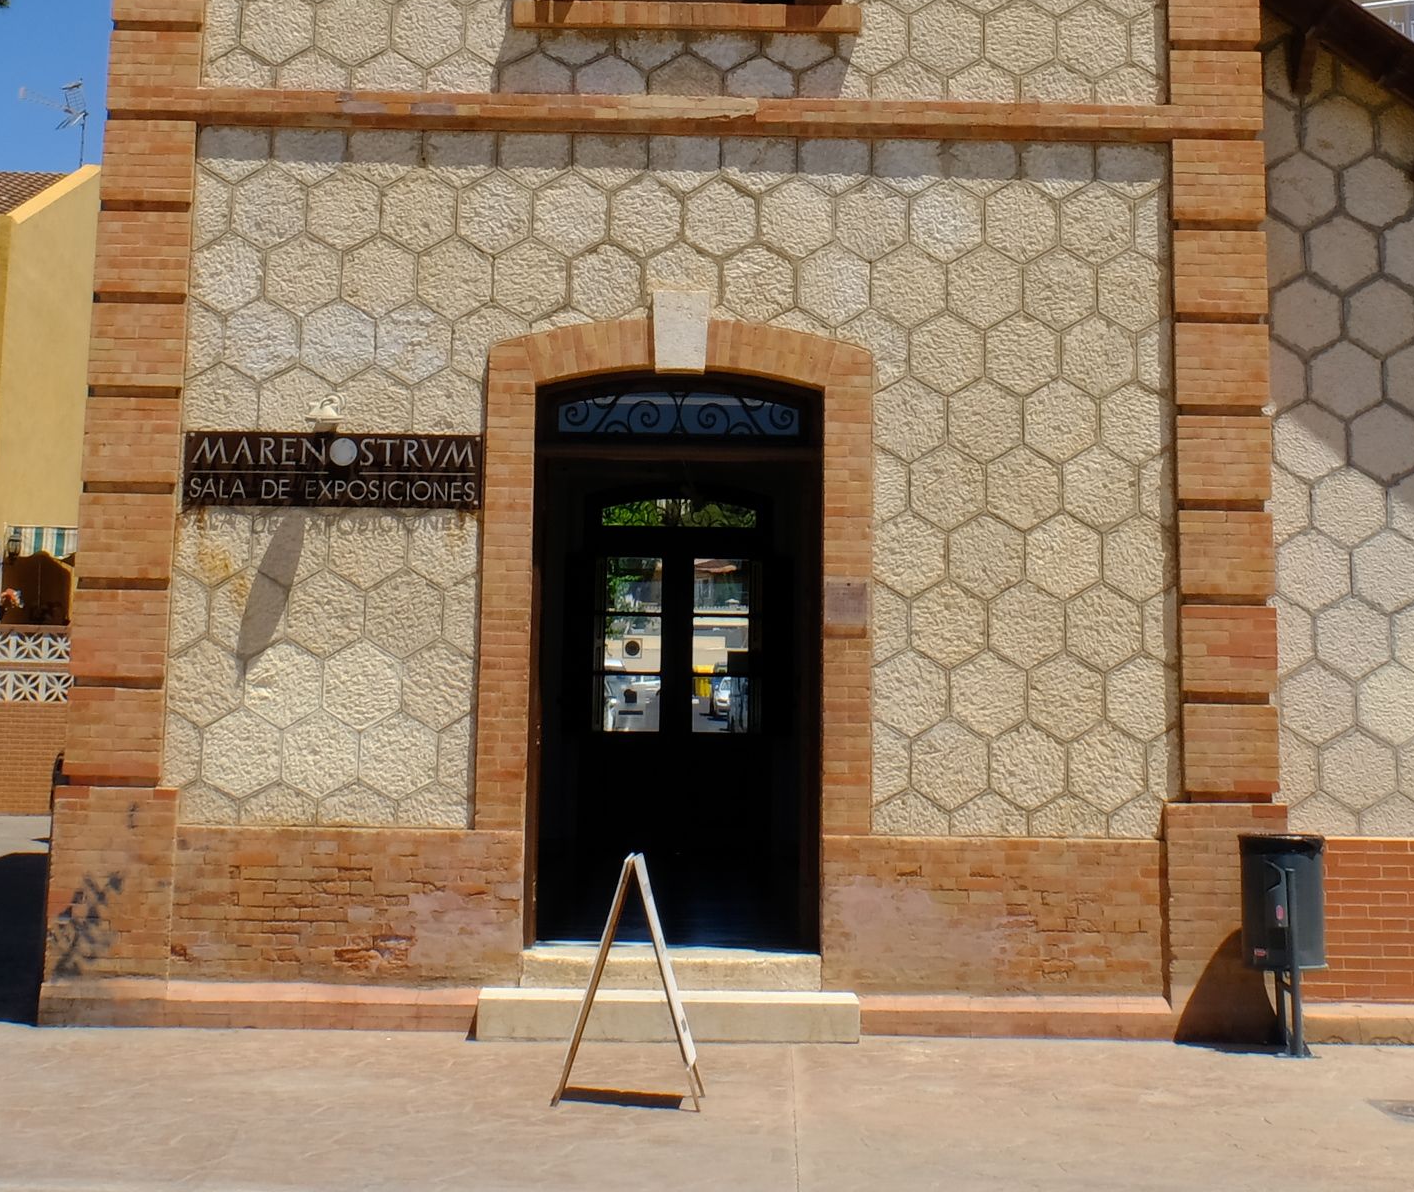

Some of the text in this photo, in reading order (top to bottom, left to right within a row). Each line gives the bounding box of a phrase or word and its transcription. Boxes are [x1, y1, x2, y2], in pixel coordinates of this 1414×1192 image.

[189, 478, 476, 502] SALA DE EXPOSICIONES
